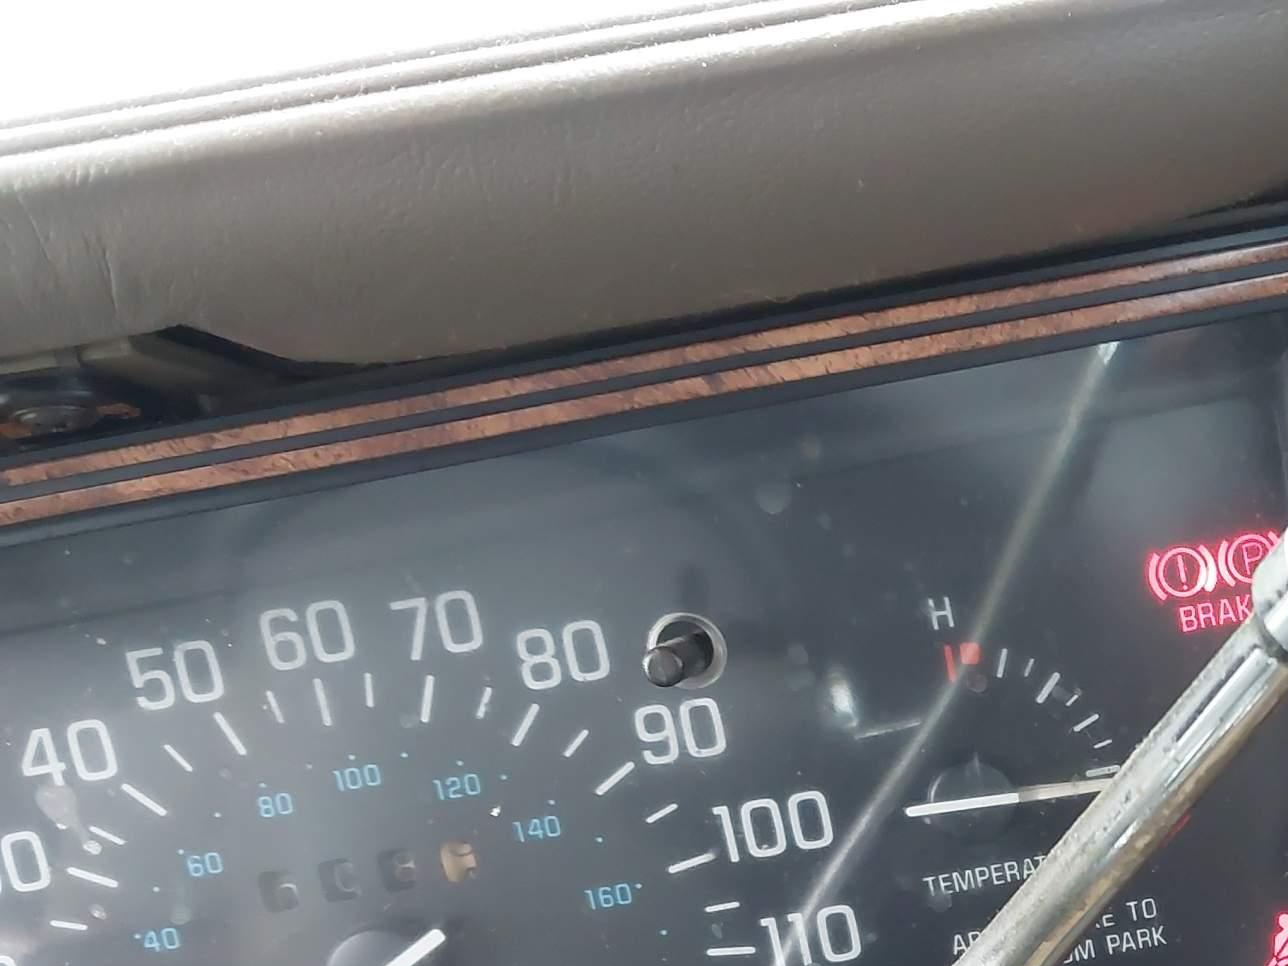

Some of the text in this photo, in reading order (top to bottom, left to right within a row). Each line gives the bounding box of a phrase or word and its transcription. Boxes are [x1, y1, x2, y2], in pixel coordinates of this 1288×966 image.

[390, 591, 483, 661] 70
[928, 596, 955, 630] H
[1179, 594, 1252, 632] BRAK
[258, 601, 355, 671] 60
[516, 620, 610, 690] 80
[125, 640, 225, 711] 50
[634, 697, 727, 765] 90
[20, 720, 118, 786] 40
[332, 764, 382, 792] 100
[433, 773, 481, 800] 120
[258, 793, 294, 818] 80
[513, 815, 561, 842] 140
[712, 791, 834, 863] 100
[0, 831, 51, 892] 0
[188, 852, 224, 877] 60
[584, 882, 633, 911] 160
[1126, 898, 1157, 923] TO
[143, 927, 181, 952] 40
[1106, 925, 1167, 955] PARK
